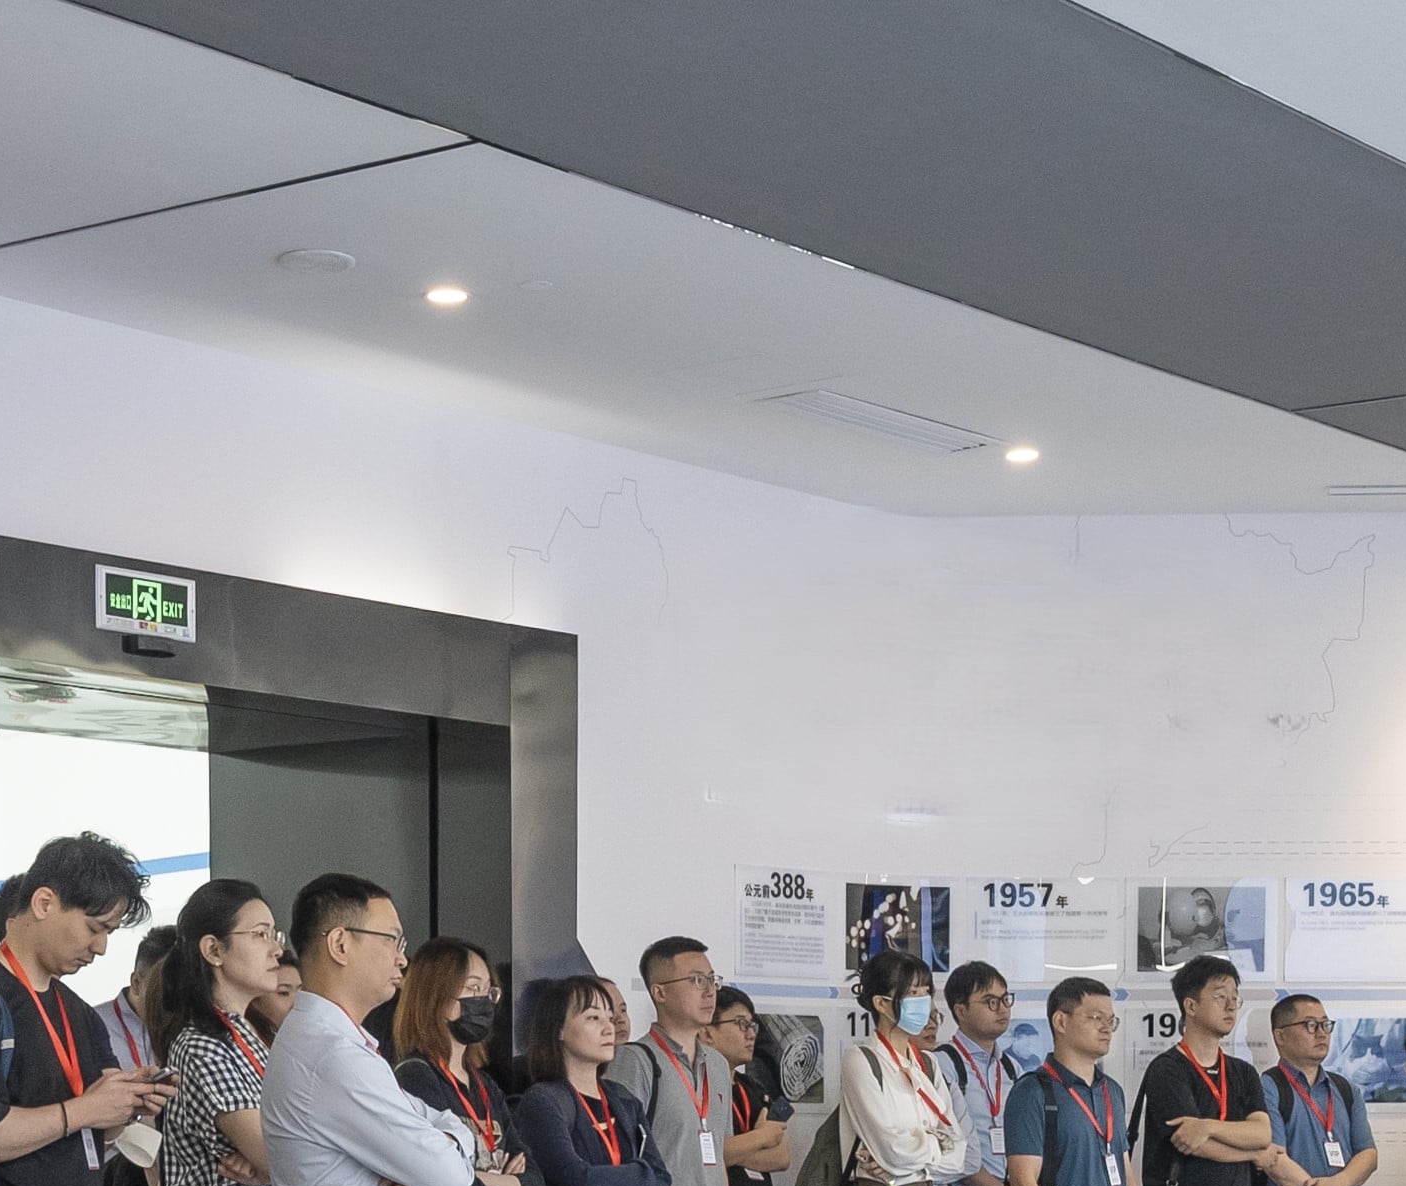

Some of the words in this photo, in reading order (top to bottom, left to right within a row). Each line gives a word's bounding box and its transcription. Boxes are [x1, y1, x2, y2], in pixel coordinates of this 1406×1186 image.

[162, 601, 184, 619] EXIT
[744, 872, 814, 902] 公元前388年
[983, 882, 1068, 909] 1957年
[1303, 882, 1390, 908] 1965年
[847, 1011, 870, 1037] 11
